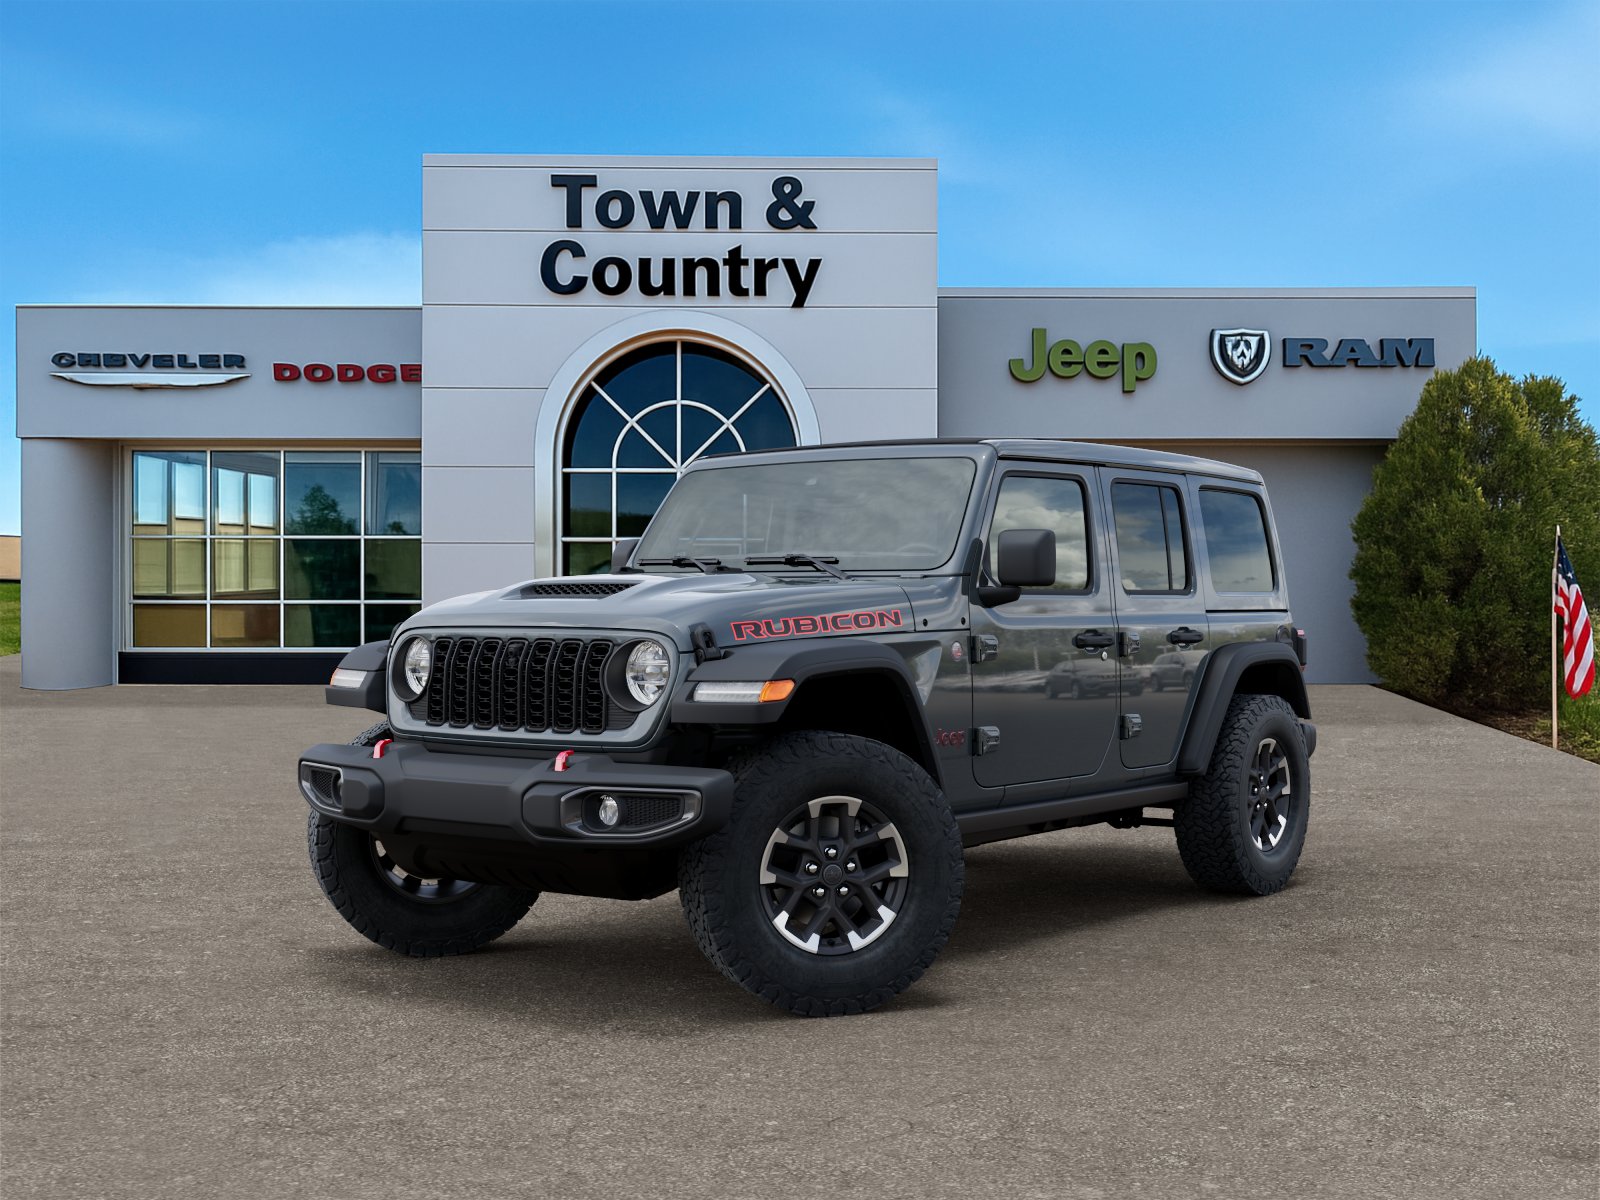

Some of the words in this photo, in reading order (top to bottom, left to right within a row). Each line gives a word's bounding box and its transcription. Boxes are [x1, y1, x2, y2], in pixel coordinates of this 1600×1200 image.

[550, 174, 743, 229] Town
[765, 176, 818, 229] &
[540, 239, 823, 308] Country
[273, 363, 422, 382] DODGE
[1008, 328, 1158, 393] Jeep
[1282, 337, 1436, 367] RAM
[731, 609, 902, 641] RUBICON
